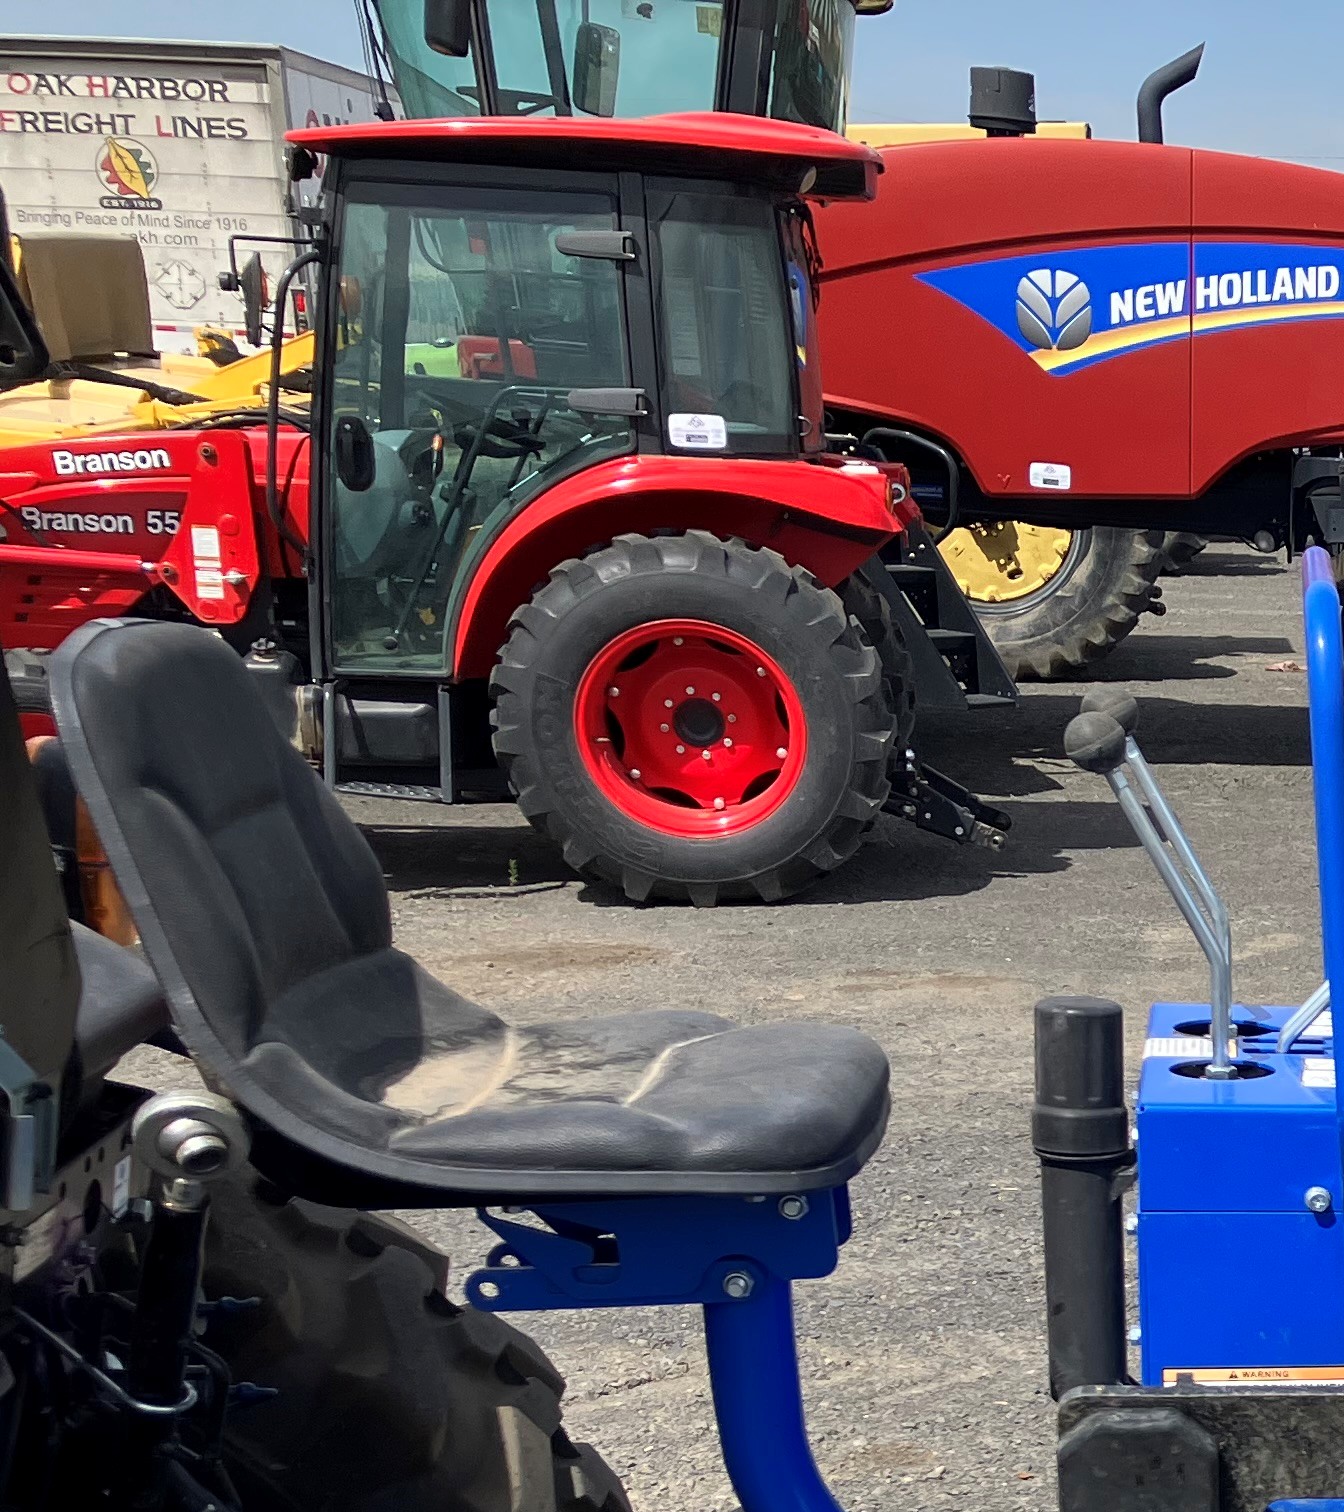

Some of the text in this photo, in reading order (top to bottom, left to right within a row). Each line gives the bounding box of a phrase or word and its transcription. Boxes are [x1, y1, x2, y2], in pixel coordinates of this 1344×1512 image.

[7, 72, 231, 102] OAK HARBOR
[0, 110, 248, 139] FREIGHT LINES
[17, 208, 248, 231] Bringing Peace of Mind Since 1916
[1110, 264, 1340, 324] NEW HOLLAND
[52, 448, 171, 475] Branson
[21, 506, 134, 534] Branson
[1242, 1370, 1289, 1378] WARNING
